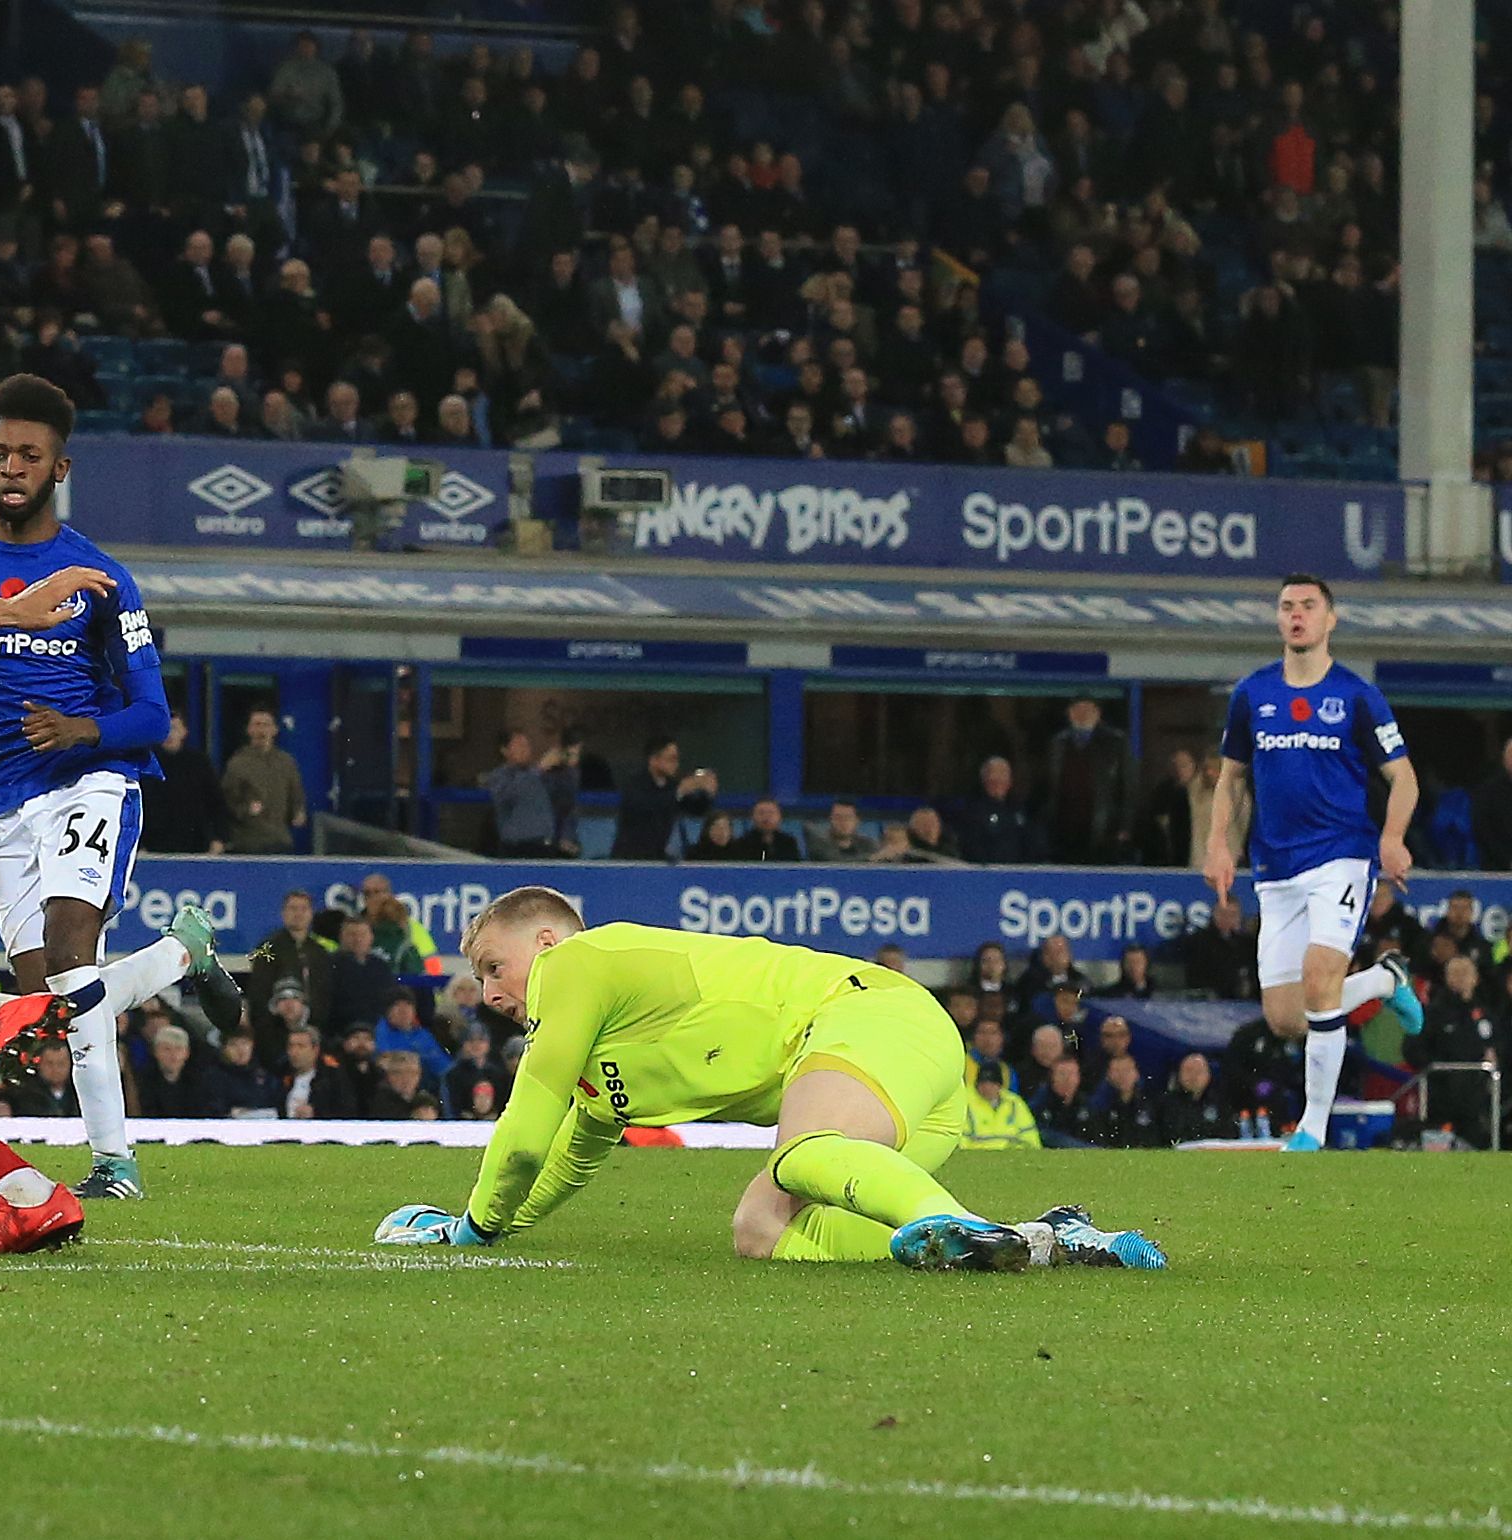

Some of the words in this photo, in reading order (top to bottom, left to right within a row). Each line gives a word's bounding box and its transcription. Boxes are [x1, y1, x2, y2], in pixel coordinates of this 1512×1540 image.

[195, 515, 265, 535] umbro
[296, 519, 353, 538] umbr
[419, 521, 487, 542] umbro
[962, 492, 1257, 561] SportPesa
[1255, 731, 1340, 751] SportPesa
[58, 812, 109, 864] 54
[1339, 883, 1356, 912] 4
[680, 886, 931, 943] SportPesa
[998, 889, 1210, 945] SportPes
